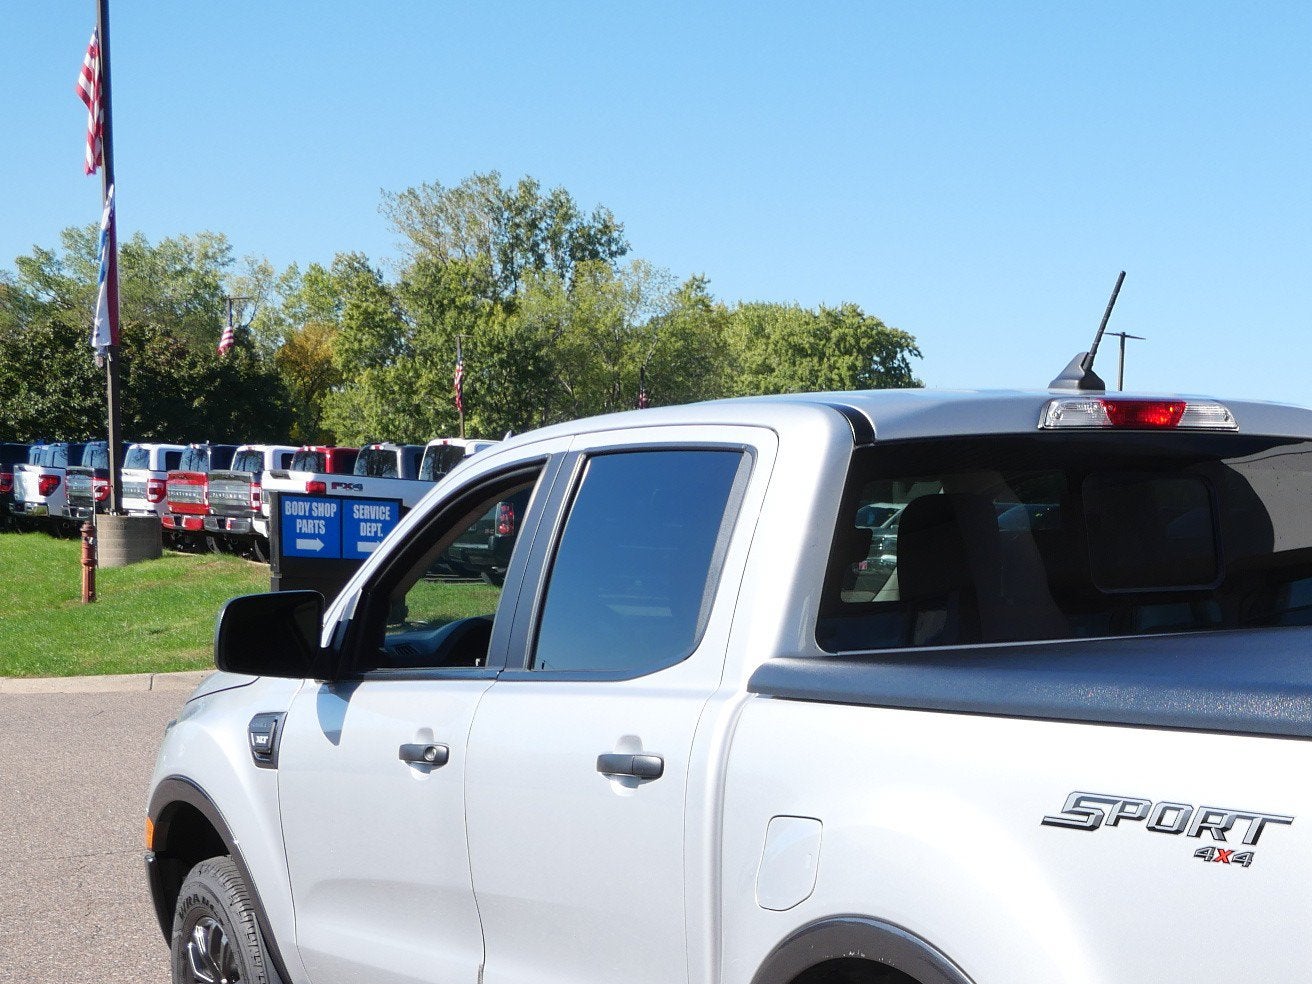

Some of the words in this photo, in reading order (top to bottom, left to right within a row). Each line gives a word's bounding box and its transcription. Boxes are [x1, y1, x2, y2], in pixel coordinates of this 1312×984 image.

[285, 501, 310, 516] BODY
[311, 501, 337, 518] SHOP
[353, 504, 391, 521] SERVICE
[296, 519, 326, 535] PARTS
[360, 522, 384, 537] DEPT.
[1041, 791, 1295, 846] SPORT
